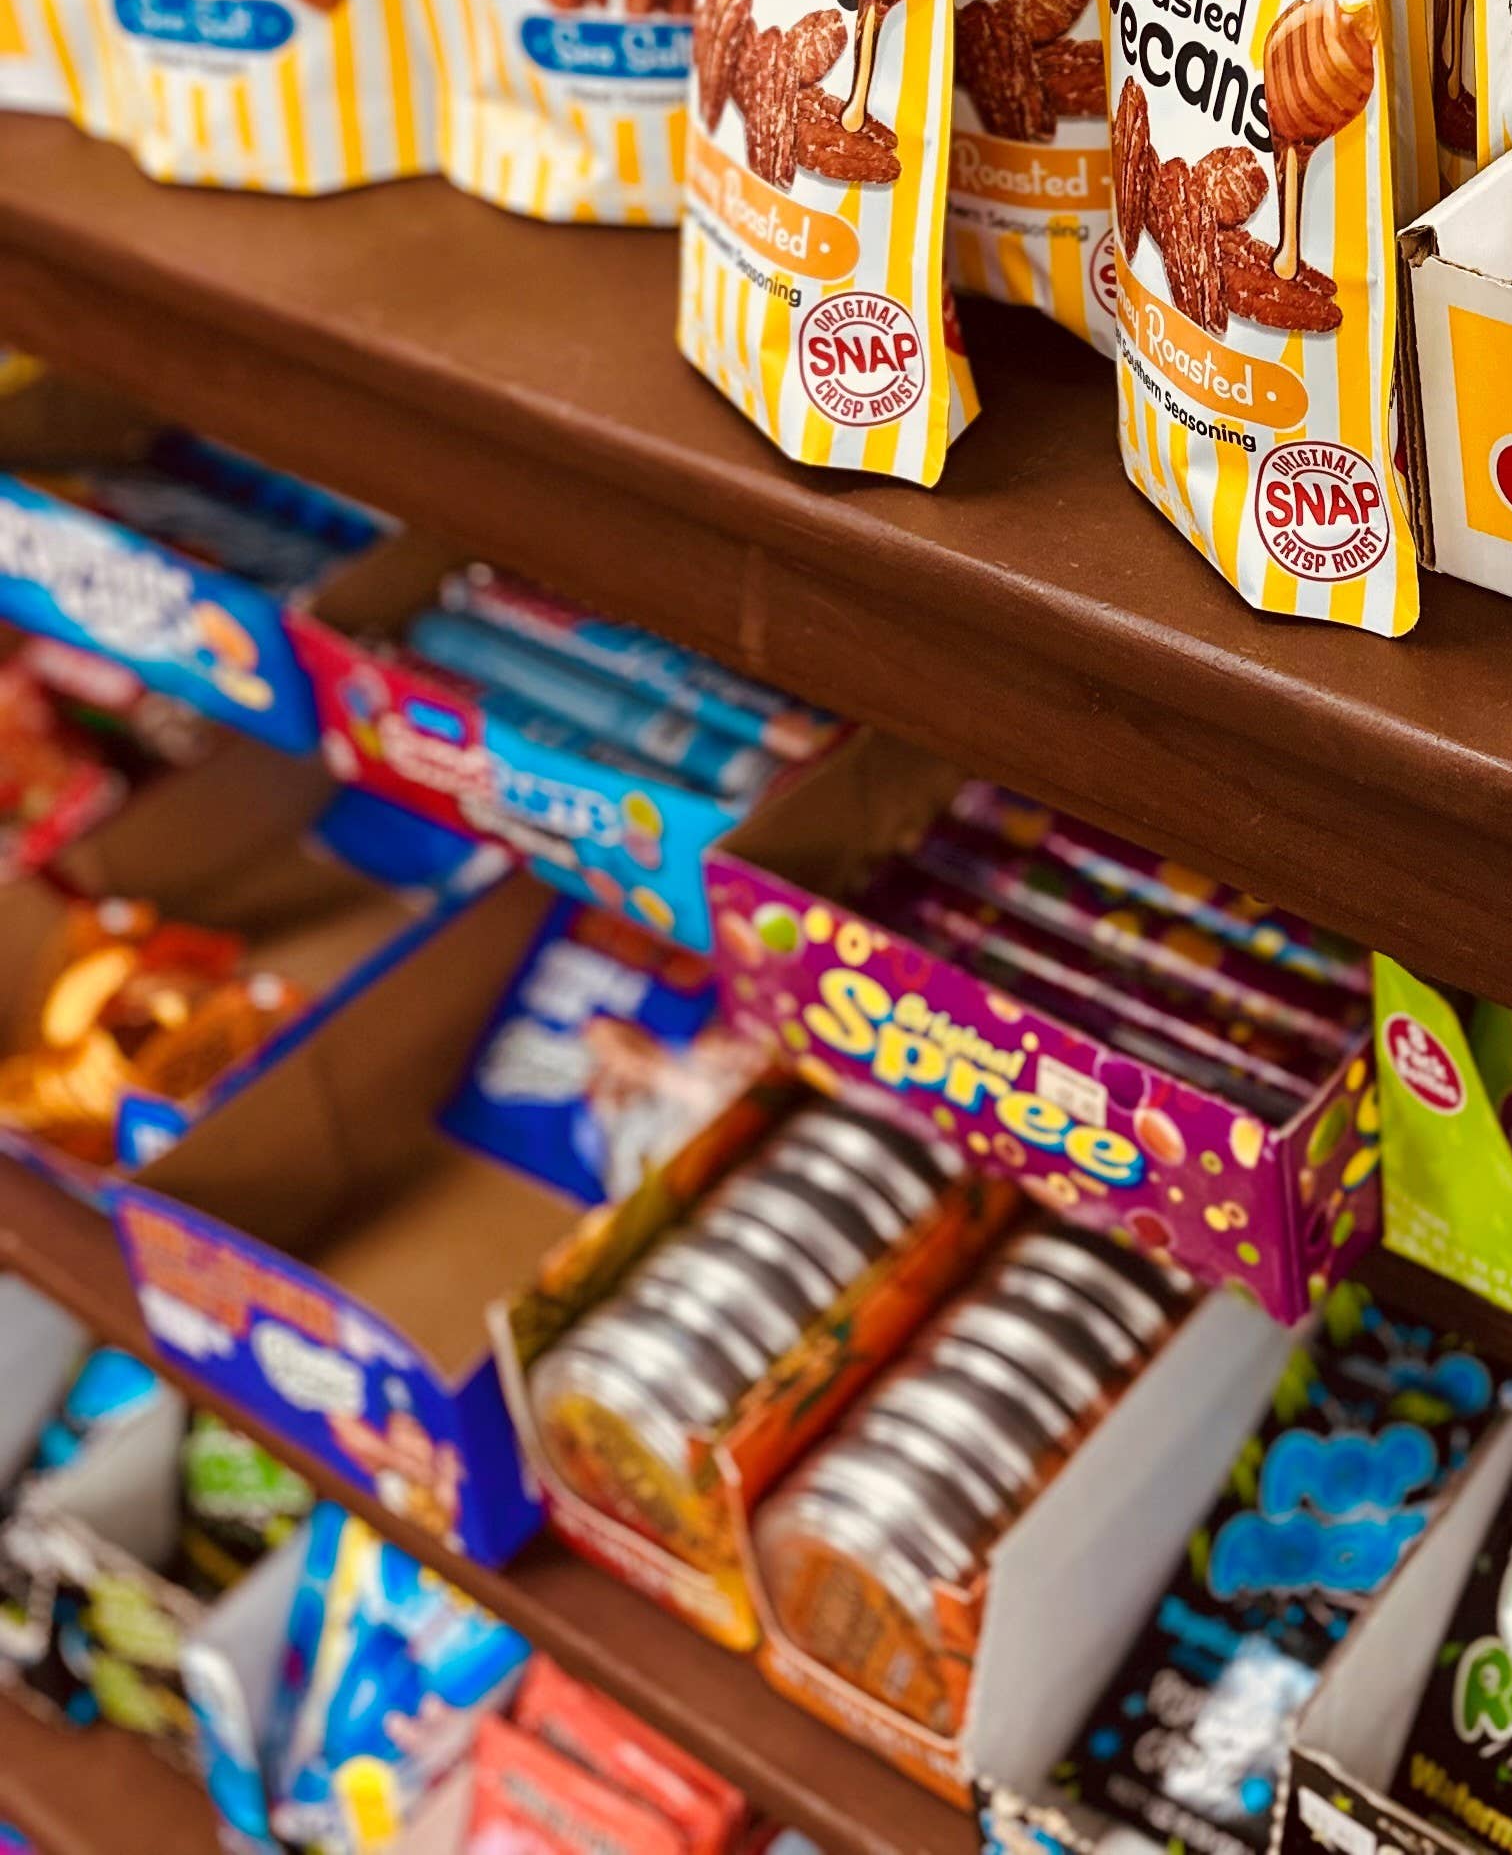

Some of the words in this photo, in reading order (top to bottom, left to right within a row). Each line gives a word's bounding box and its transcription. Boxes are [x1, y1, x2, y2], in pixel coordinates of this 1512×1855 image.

[953, 138, 1089, 197] Roasted
[815, 299, 900, 332] ORIGINAL
[808, 331, 919, 378] SNAP
[1144, 302, 1254, 407] Roasted
[815, 377, 865, 420] CRISP
[869, 372, 921, 418] ROAST
[1164, 390, 1257, 453] Seasoning
[1272, 447, 1355, 480] ORIGINAL
[1265, 474, 1381, 529] SNAP
[1272, 530, 1327, 575] CRISP
[1331, 525, 1385, 570] ROAST
[803, 966, 1147, 1188] Spree
